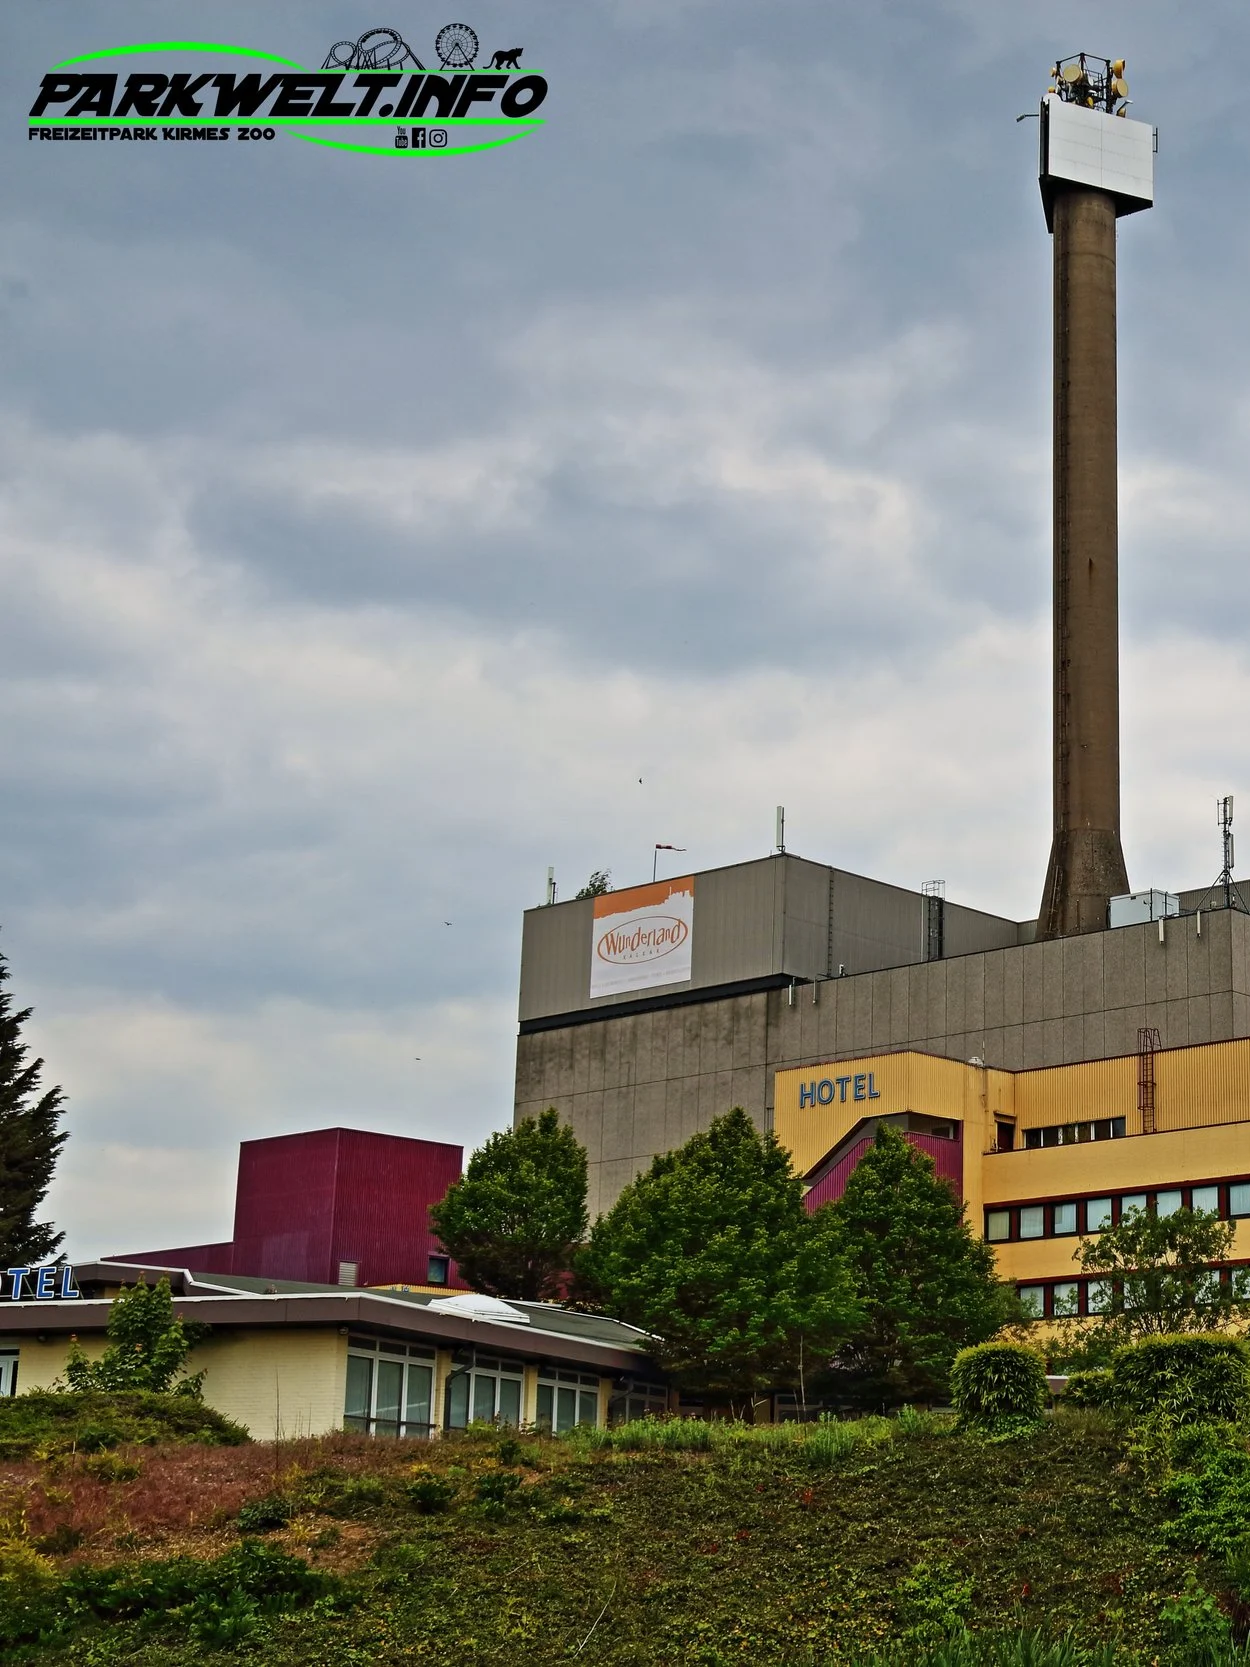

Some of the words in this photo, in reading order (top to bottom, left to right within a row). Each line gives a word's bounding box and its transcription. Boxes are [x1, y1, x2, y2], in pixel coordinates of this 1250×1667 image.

[604, 918, 681, 956] Wunderland
[800, 1072, 880, 1109] HOTEL
[0, 1265, 79, 1300] TEL
